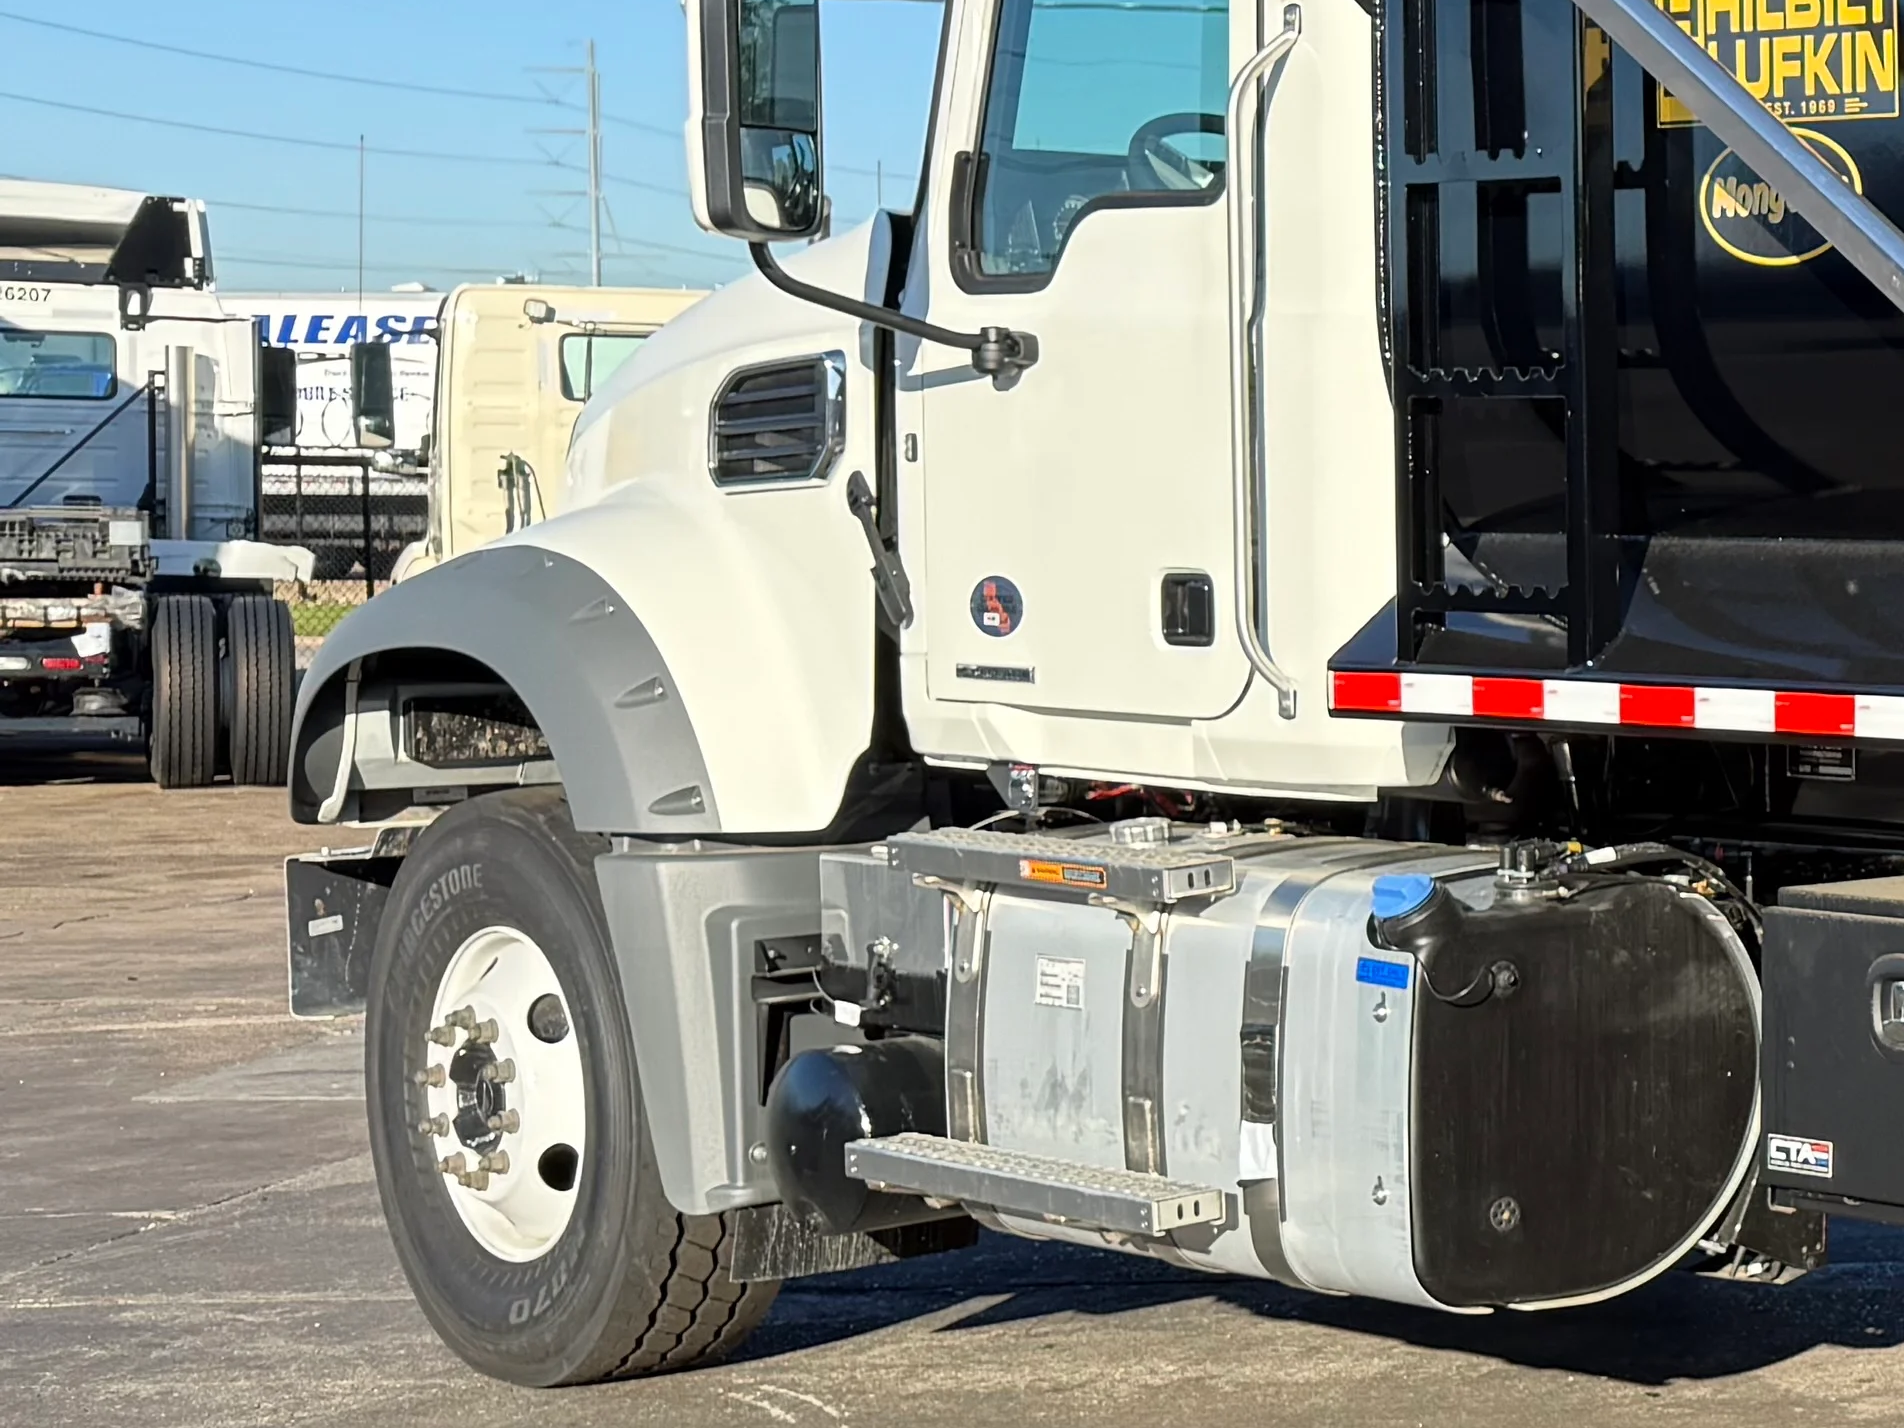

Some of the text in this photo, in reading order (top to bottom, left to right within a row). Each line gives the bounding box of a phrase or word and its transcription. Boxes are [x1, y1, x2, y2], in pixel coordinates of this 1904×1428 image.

[1708, 29, 1894, 100] UFKIN
[1712, 176, 1798, 224] Mong
[0, 286, 51, 302] 6207
